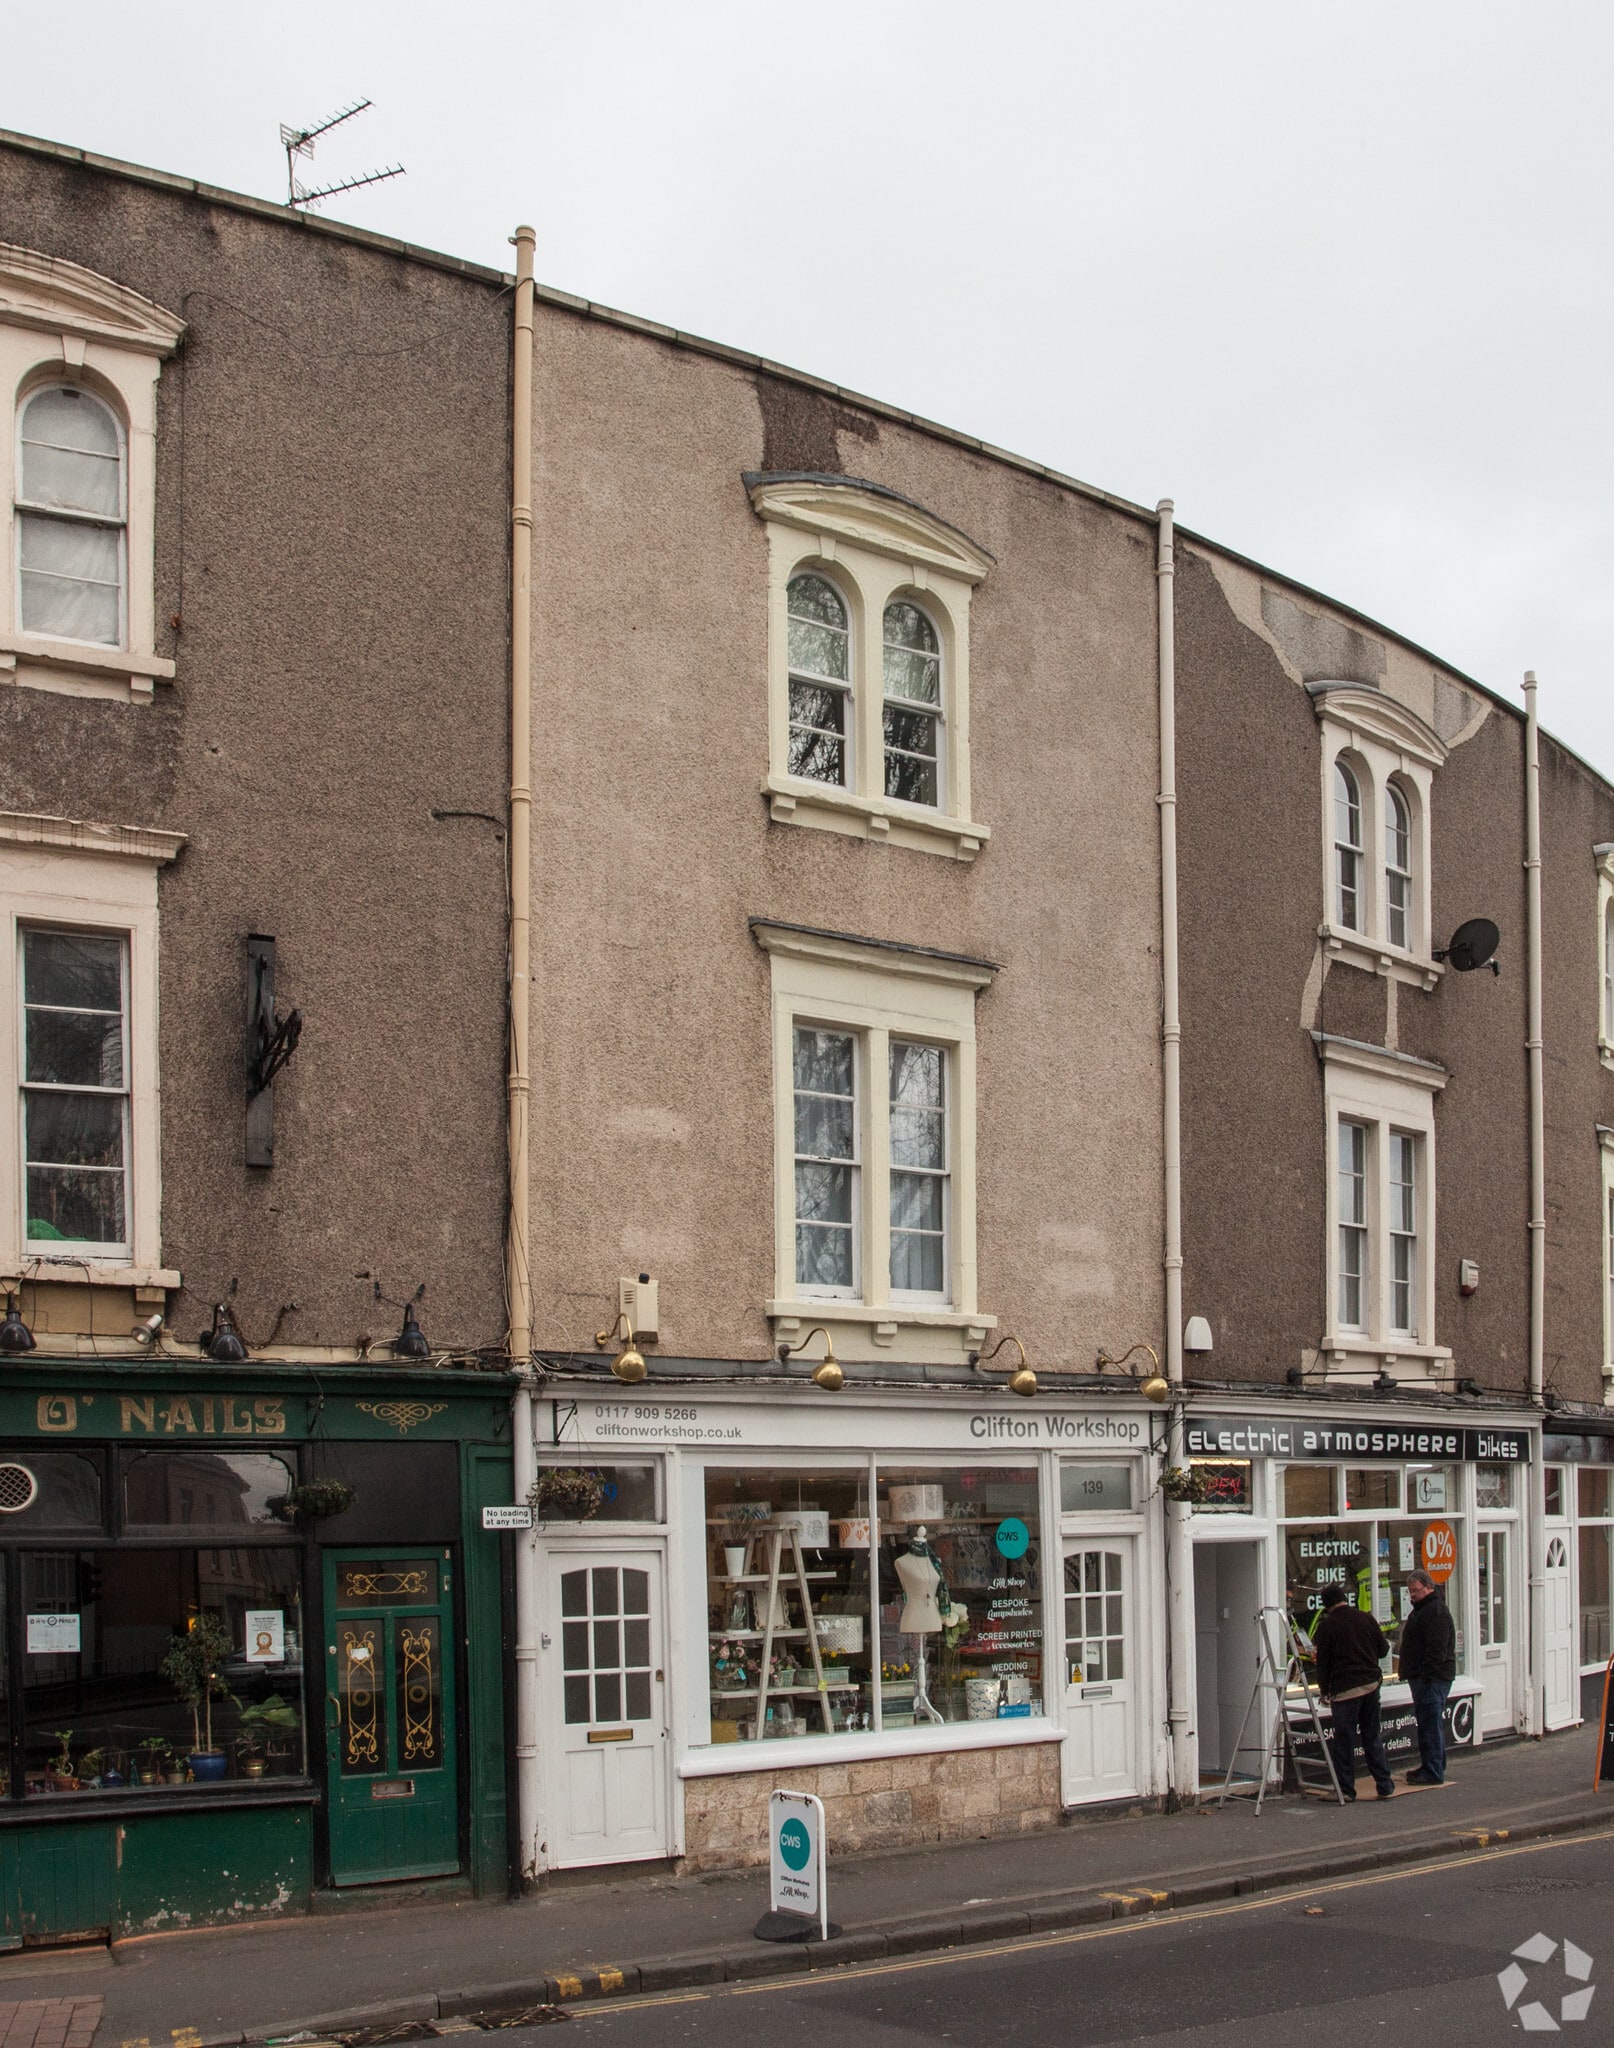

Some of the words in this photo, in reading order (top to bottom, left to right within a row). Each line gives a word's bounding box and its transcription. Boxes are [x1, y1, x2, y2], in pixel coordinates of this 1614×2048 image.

[119, 1396, 286, 1434] NAILS
[595, 1406, 629, 1418] 0117
[634, 1407, 660, 1419] 909
[664, 1408, 697, 1421] 5266
[595, 1424, 742, 1439] cliftonworkshop.co.uk
[970, 1415, 1039, 1438] Clifton
[1045, 1416, 1140, 1442] Workshop
[1082, 1481, 1103, 1494] 139
[500, 1510, 529, 1518] loading
[997, 1531, 1019, 1542] CWS
[1300, 1540, 1360, 1557] ELECTRIC
[1425, 1530, 1453, 1559] 0%
[1427, 1562, 1453, 1571] finance
[1316, 1567, 1346, 1583] BIKE
[992, 1599, 1029, 1609] BESPOKE
[986, 1608, 1033, 1621] Lampshades
[977, 1632, 1009, 1642] SCREEN
[1010, 1629, 1044, 1640] PRINTED
[988, 1640, 1034, 1650] Accessories
[991, 1661, 1028, 1672] WEDDING
[1379, 1717, 1395, 1733] year
[1387, 1736, 1412, 1750] details
[780, 1833, 801, 1849] CWS
